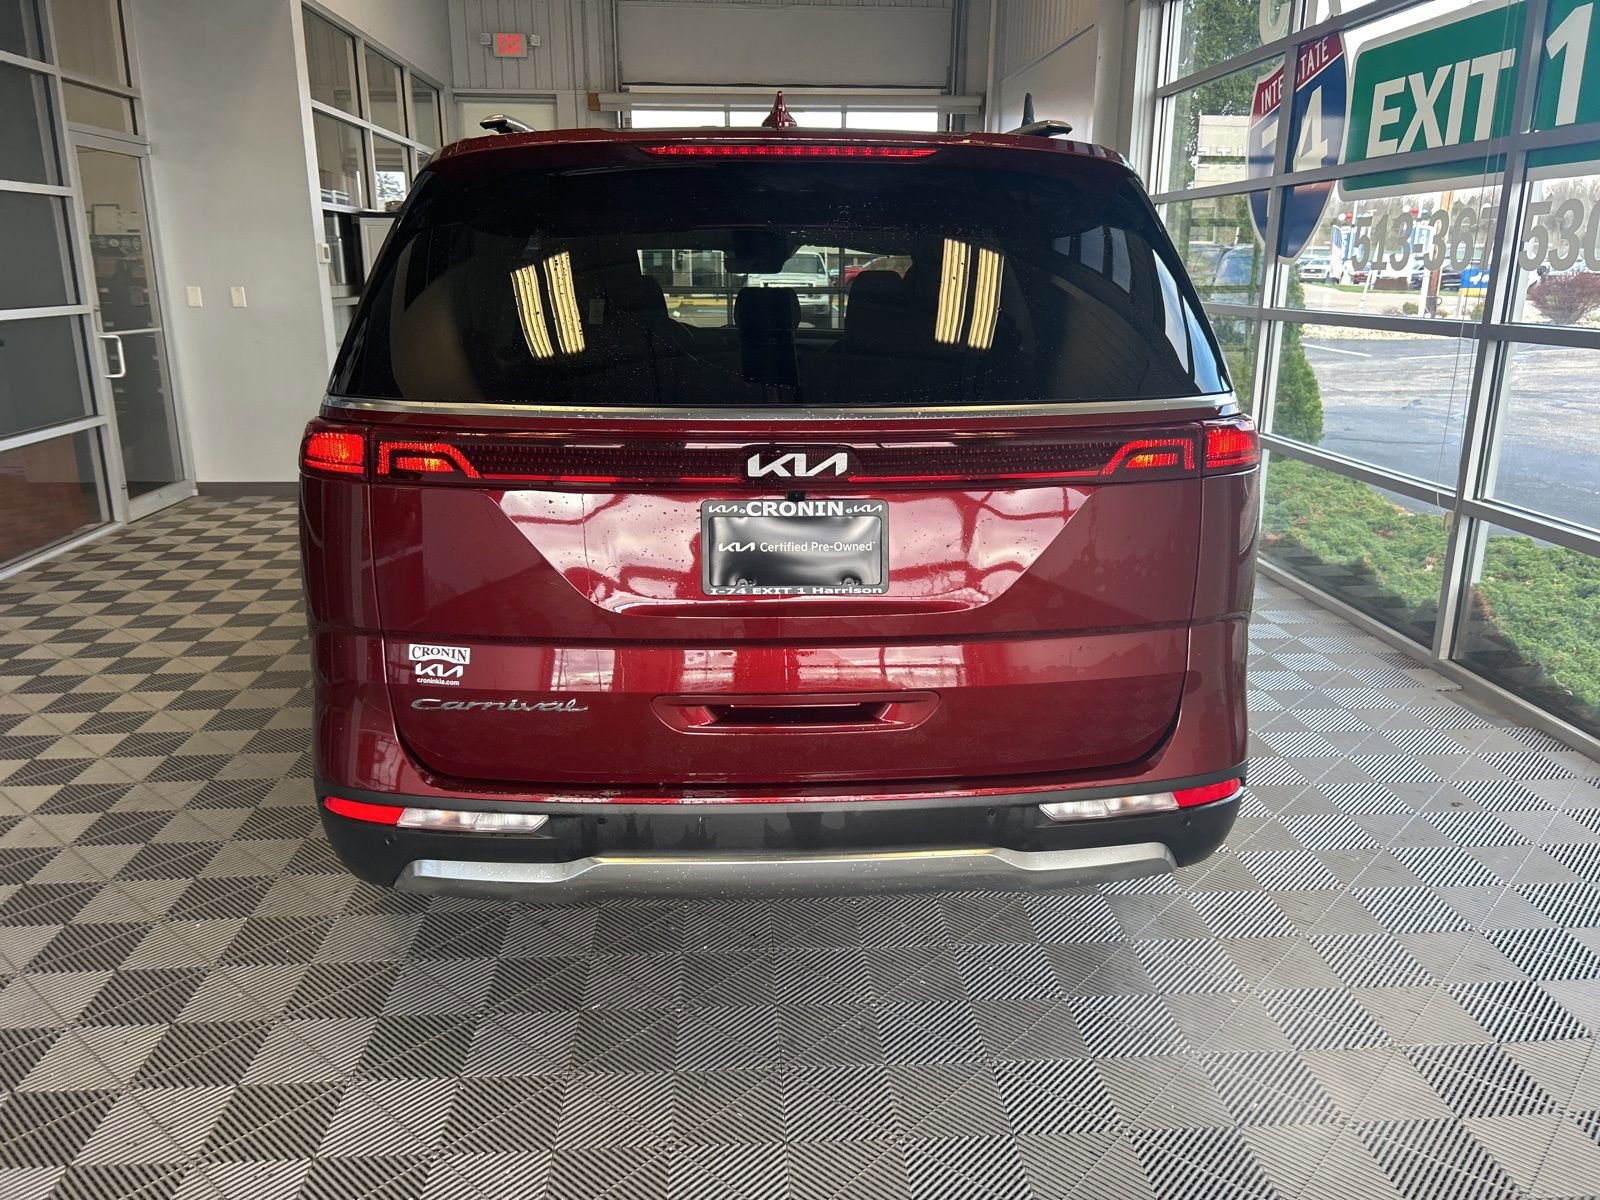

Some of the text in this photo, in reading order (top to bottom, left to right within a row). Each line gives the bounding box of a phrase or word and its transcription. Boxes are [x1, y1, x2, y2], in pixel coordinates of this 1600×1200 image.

[1366, 2, 1593, 158] EXIT 1
[747, 452, 848, 477] KIA
[746, 501, 844, 517] CRONIN
[759, 541, 808, 553] Certified
[811, 541, 873, 552] Pre-Owned
[752, 587, 792, 595] EXIT
[797, 587, 806, 595] 1
[812, 587, 883, 595] Harrison
[412, 645, 467, 662] CRONIN
[416, 677, 460, 686] croninkia.com
[410, 698, 589, 712] Carnival
